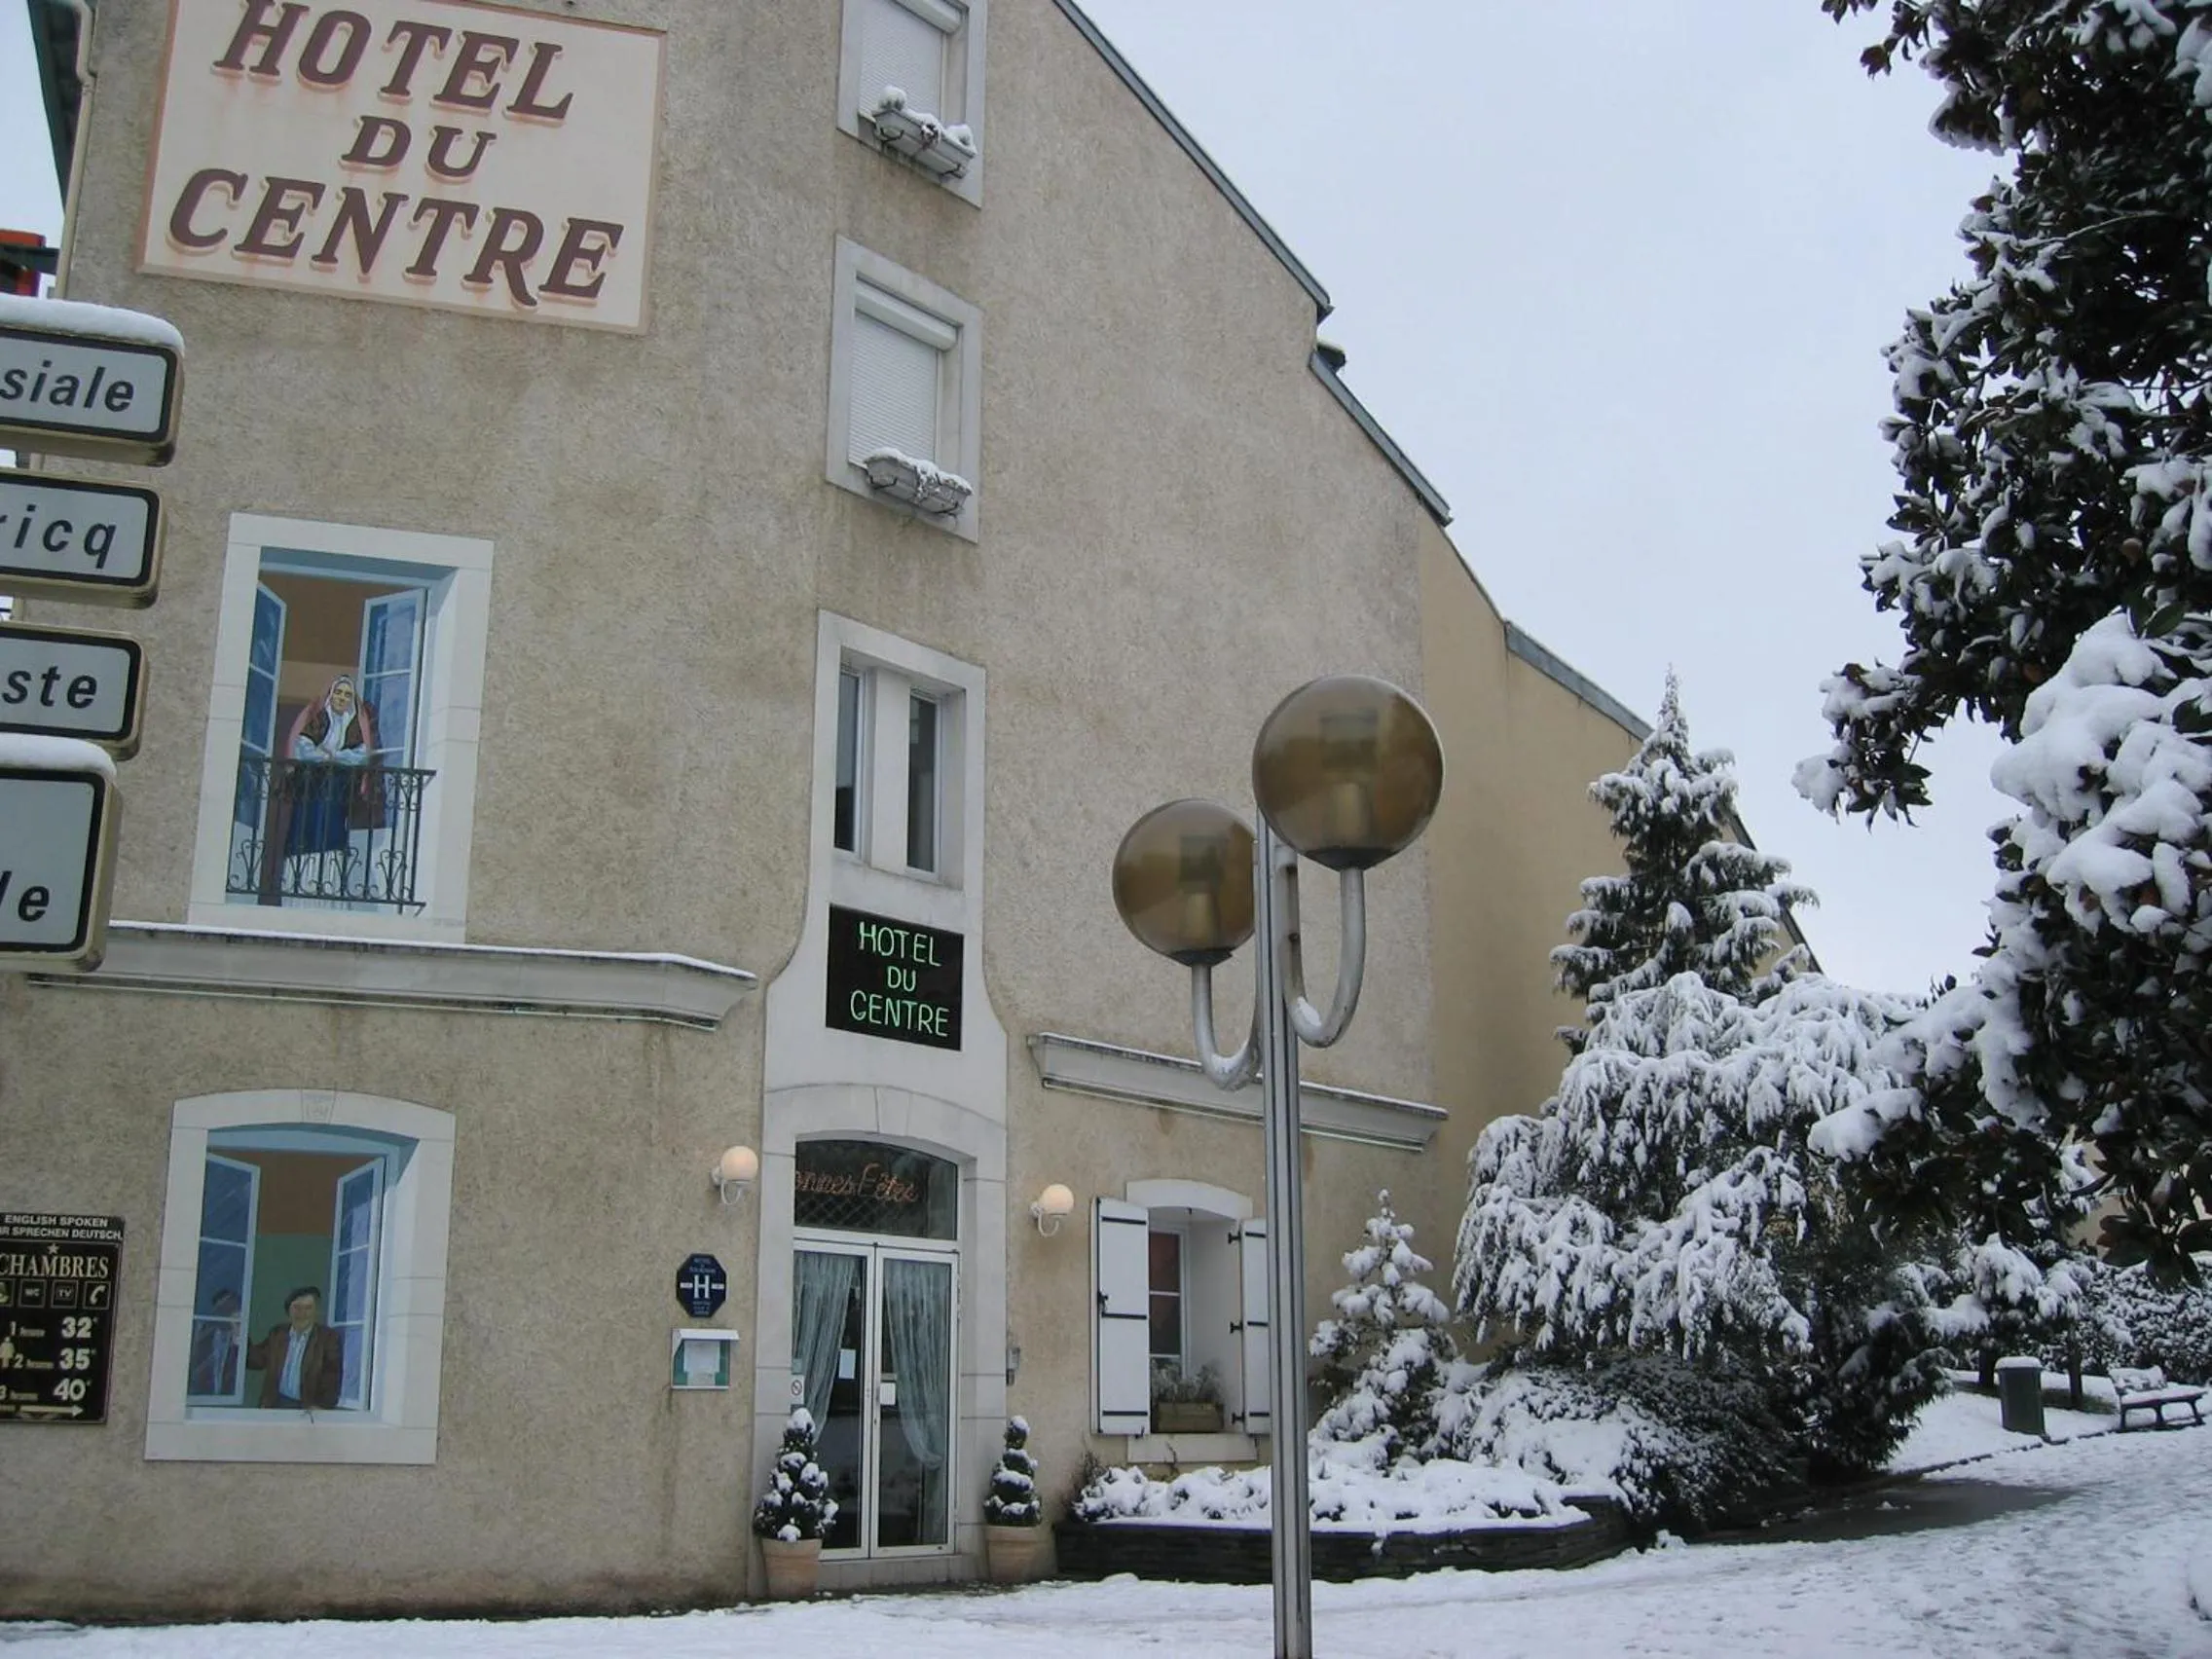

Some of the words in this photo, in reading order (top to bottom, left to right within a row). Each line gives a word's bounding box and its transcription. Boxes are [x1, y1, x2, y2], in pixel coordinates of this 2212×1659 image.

[213, 0, 574, 120] HOTEL
[340, 115, 498, 178] DU
[167, 167, 624, 308] CENTRE
[0, 359, 134, 413] siale
[0, 504, 117, 569] icq
[2, 666, 97, 709] ste
[859, 921, 942, 967] HOTEL
[887, 965, 916, 992] DU
[850, 989, 950, 1038] CENTRE
[5, 1214, 57, 1227] ENGLISH
[59, 1216, 109, 1228] SPOKEN
[12, 1227, 70, 1238] SPRECHEN
[0, 1253, 110, 1278] CHAMBRES
[693, 1274, 710, 1299] H
[14, 1353, 23, 1369] 2
